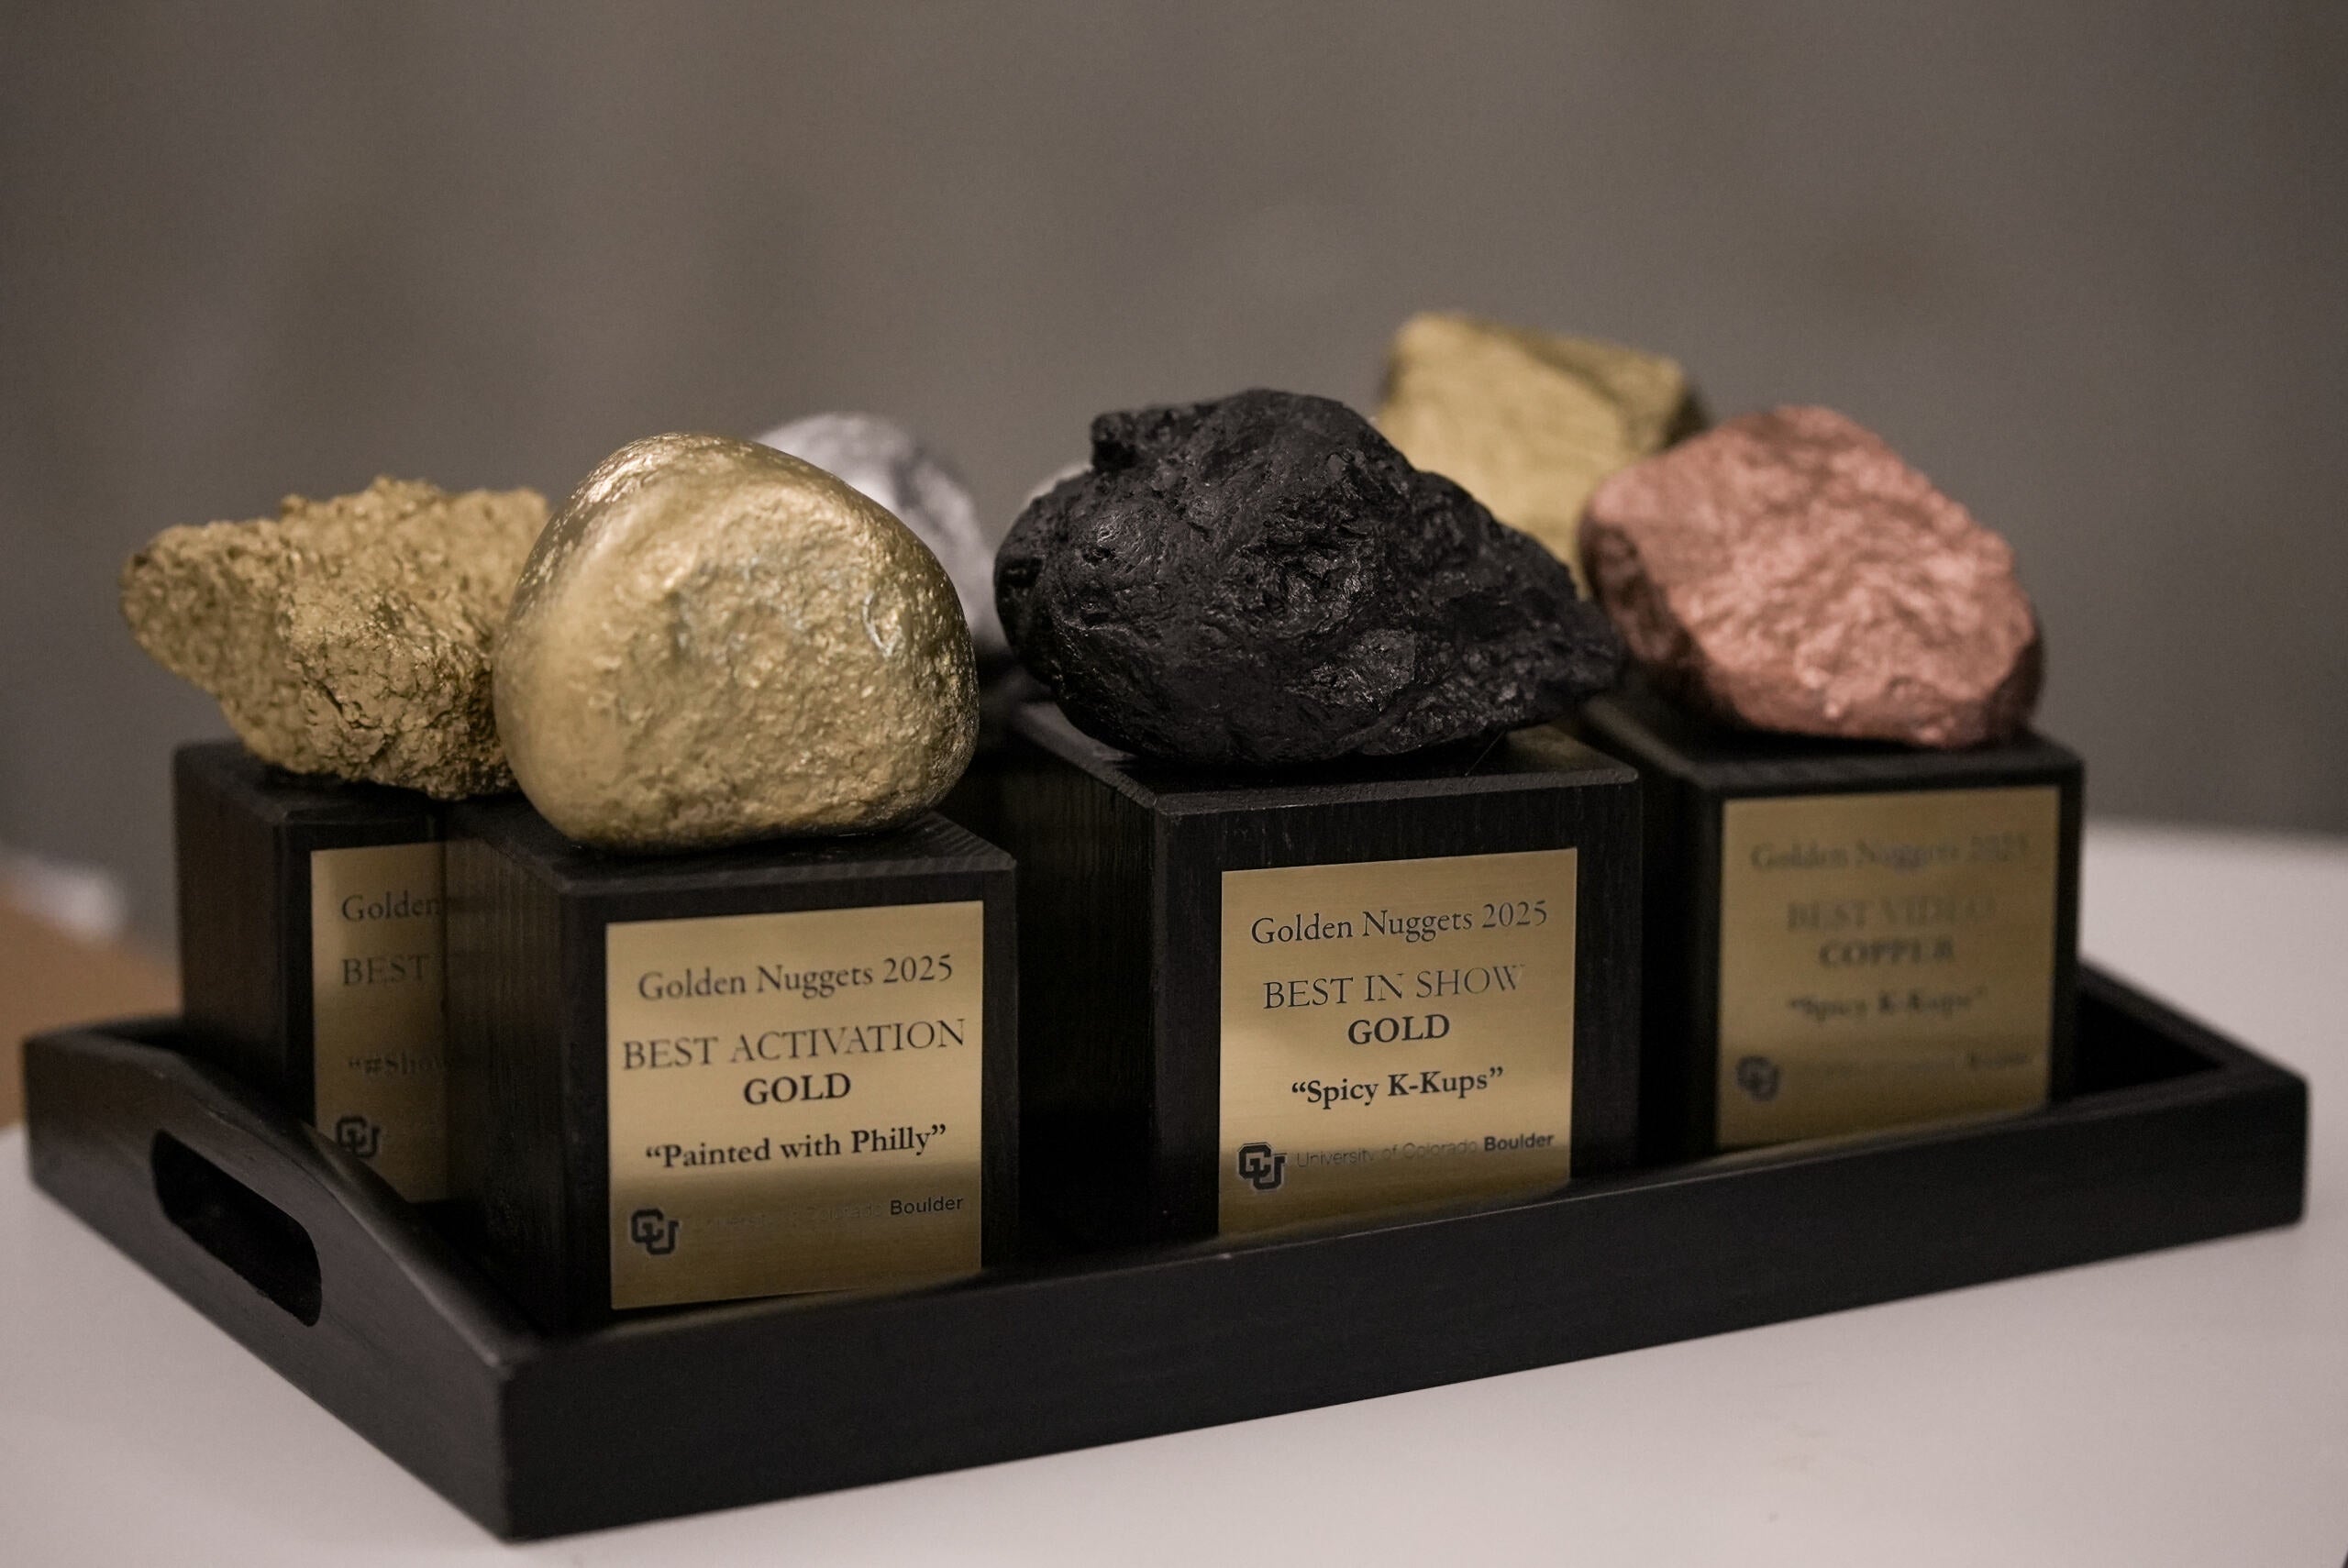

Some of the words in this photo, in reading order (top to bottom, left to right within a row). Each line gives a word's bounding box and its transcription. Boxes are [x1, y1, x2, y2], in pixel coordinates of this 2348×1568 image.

[1251, 913, 1353, 944] Golden
[1362, 910, 1472, 944] Nuggets
[1482, 900, 1548, 929] 2025
[342, 954, 430, 987] BEST
[638, 966, 746, 1001] Golden
[757, 963, 874, 1000] Nuggets
[882, 954, 953, 985] 2025
[1263, 977, 1354, 1010] BEST
[1364, 972, 1405, 1003] IN
[1416, 964, 1526, 999] SHOW
[623, 1036, 719, 1071] BEST
[730, 1018, 966, 1064] ACTIVATION
[1347, 1013, 1450, 1045] GOLD
[744, 1072, 851, 1106] GOLD
[1291, 1077, 1379, 1110] “Spicy
[1388, 1066, 1504, 1099] K-Kups”
[646, 1138, 771, 1169] “Painted
[781, 1132, 842, 1160] with
[850, 1123, 947, 1156] Philly”
[1296, 1148, 1375, 1168] University
[1381, 1143, 1399, 1161] of
[1402, 1140, 1478, 1160] Colorado
[1483, 1132, 1554, 1152] Boulder
[889, 1195, 964, 1217] Boulder
